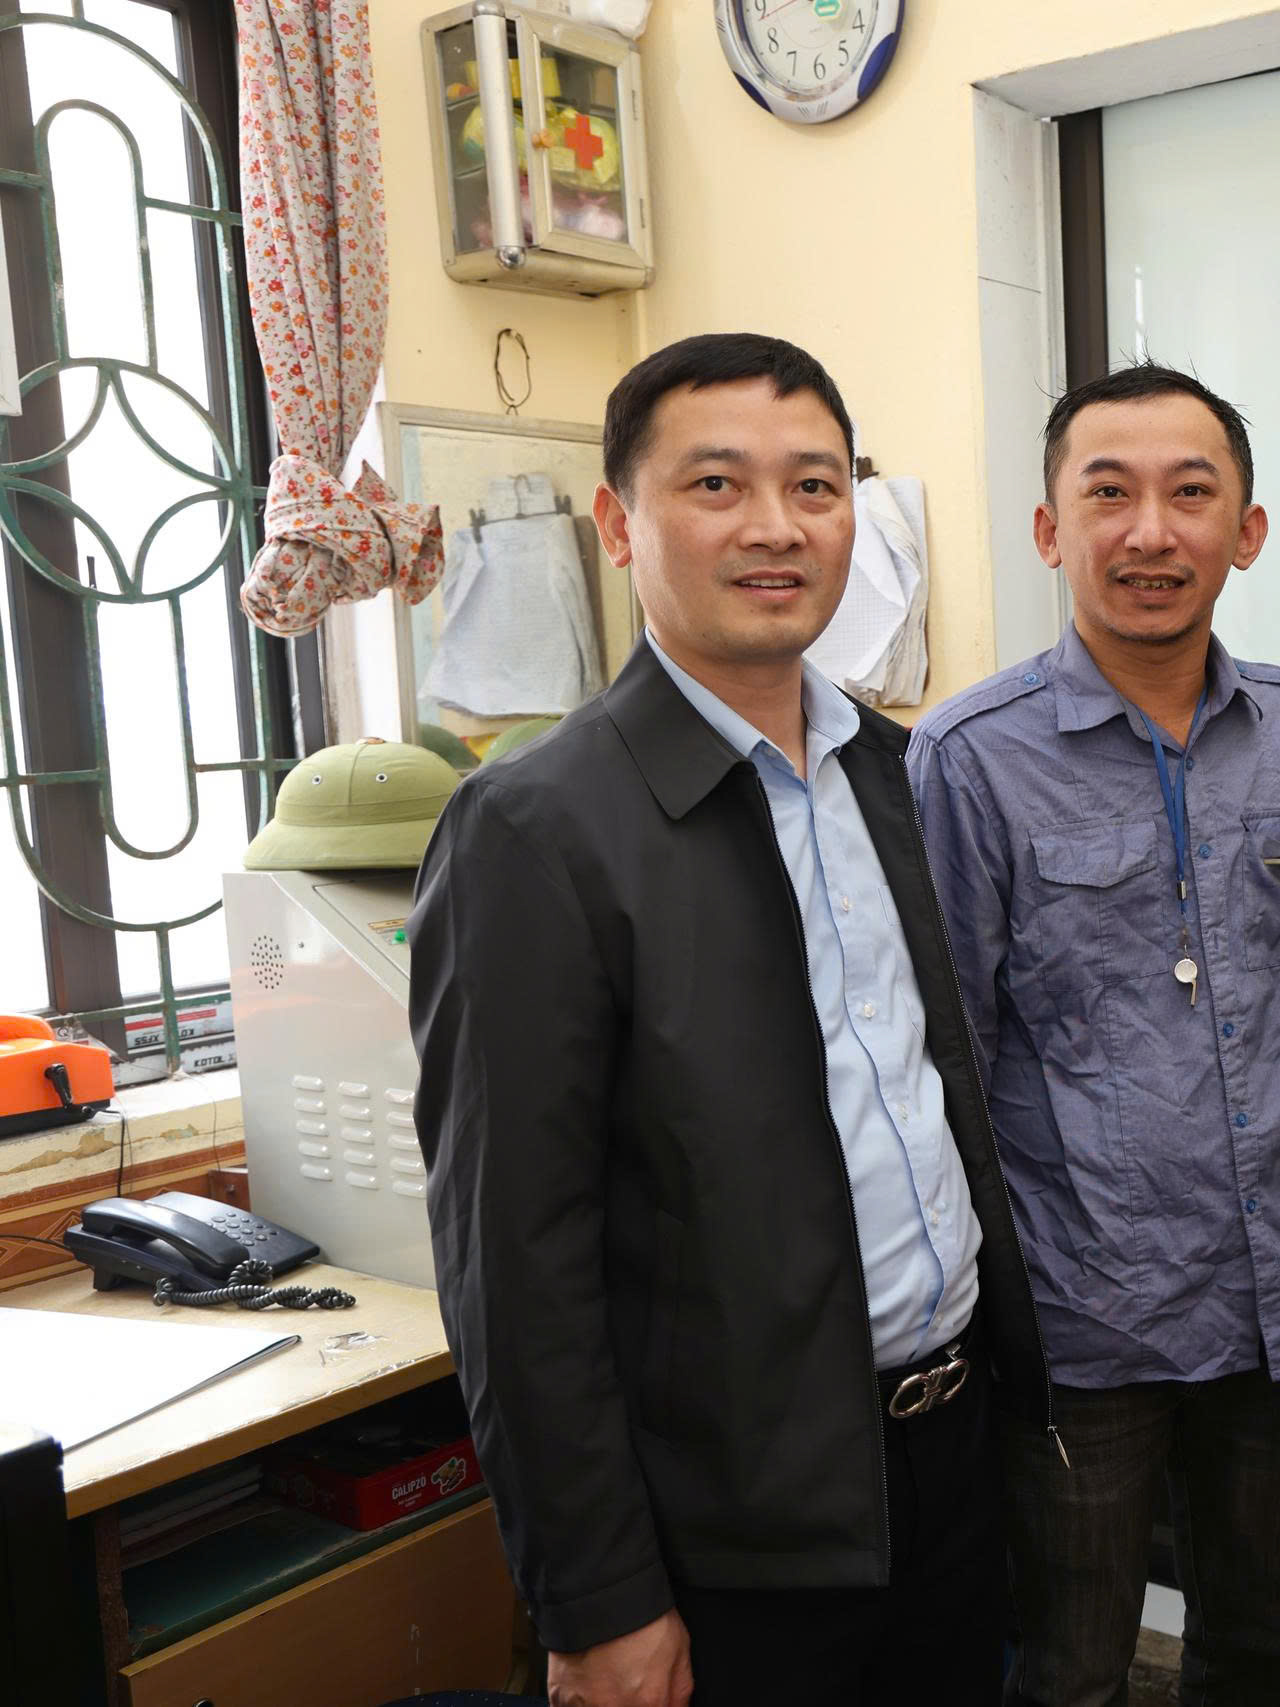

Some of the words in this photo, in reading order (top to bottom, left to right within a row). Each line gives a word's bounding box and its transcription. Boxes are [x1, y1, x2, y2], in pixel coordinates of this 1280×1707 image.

[852, 8, 865, 34] 4
[767, 27, 780, 54] 8
[838, 40, 849, 67] 5
[786, 51, 798, 77] 7
[813, 53, 826, 80] 6
